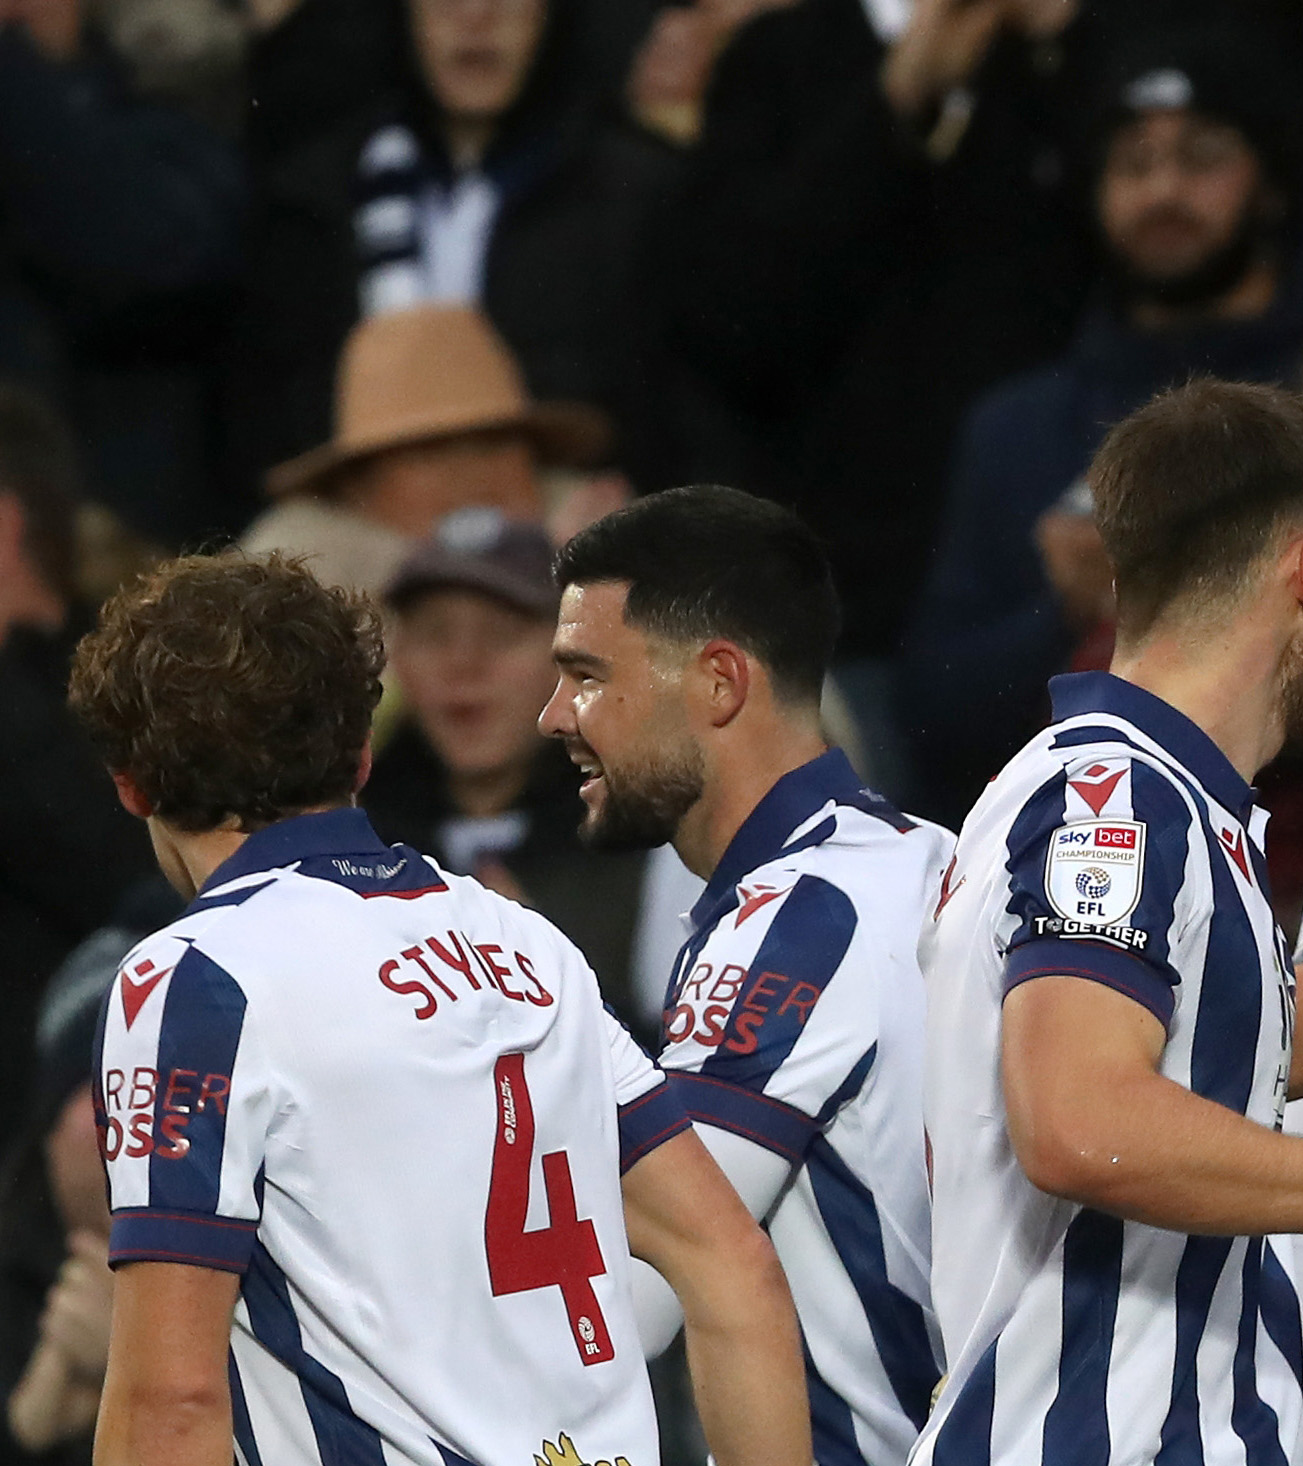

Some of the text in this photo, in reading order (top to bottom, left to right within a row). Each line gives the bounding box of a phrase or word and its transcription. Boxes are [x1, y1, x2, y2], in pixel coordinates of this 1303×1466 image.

[1059, 829, 1132, 845] sky bet
[1056, 850, 1135, 860] CHAMPIONSHIP
[1076, 901, 1106, 916] EFL
[378, 928, 555, 1020] STYLES
[485, 1052, 607, 1366] 4
[585, 1342, 600, 1355] EFL
